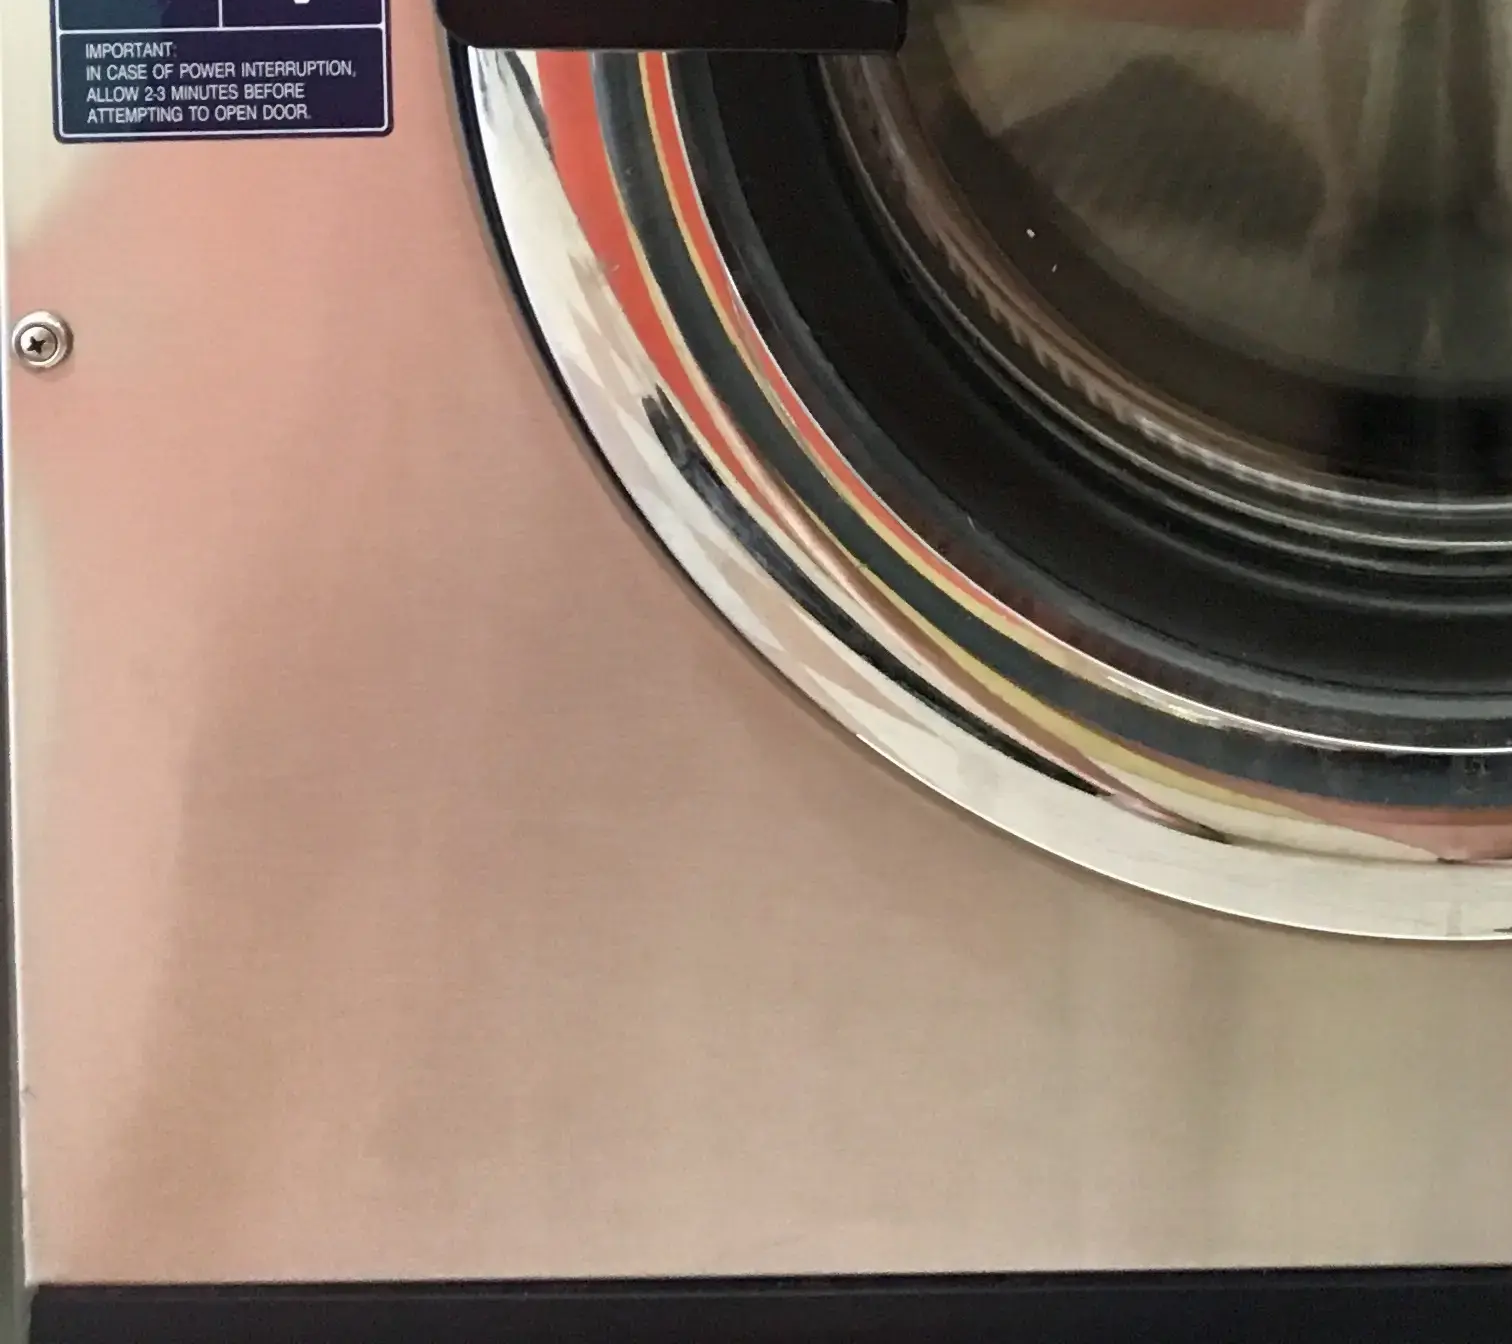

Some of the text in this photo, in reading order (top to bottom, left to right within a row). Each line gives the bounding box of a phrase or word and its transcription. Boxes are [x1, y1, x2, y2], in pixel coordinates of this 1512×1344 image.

[86, 65, 101, 81] IN
[106, 64, 147, 81] CASE
[152, 63, 173, 80] OF
[180, 62, 235, 79] POWER
[86, 83, 305, 102] ALLOW 2-3 MINUTES BEFORE
[87, 106, 183, 123] ATTEMPTING
[188, 106, 209, 121] TO
[215, 105, 257, 121] OPEN
